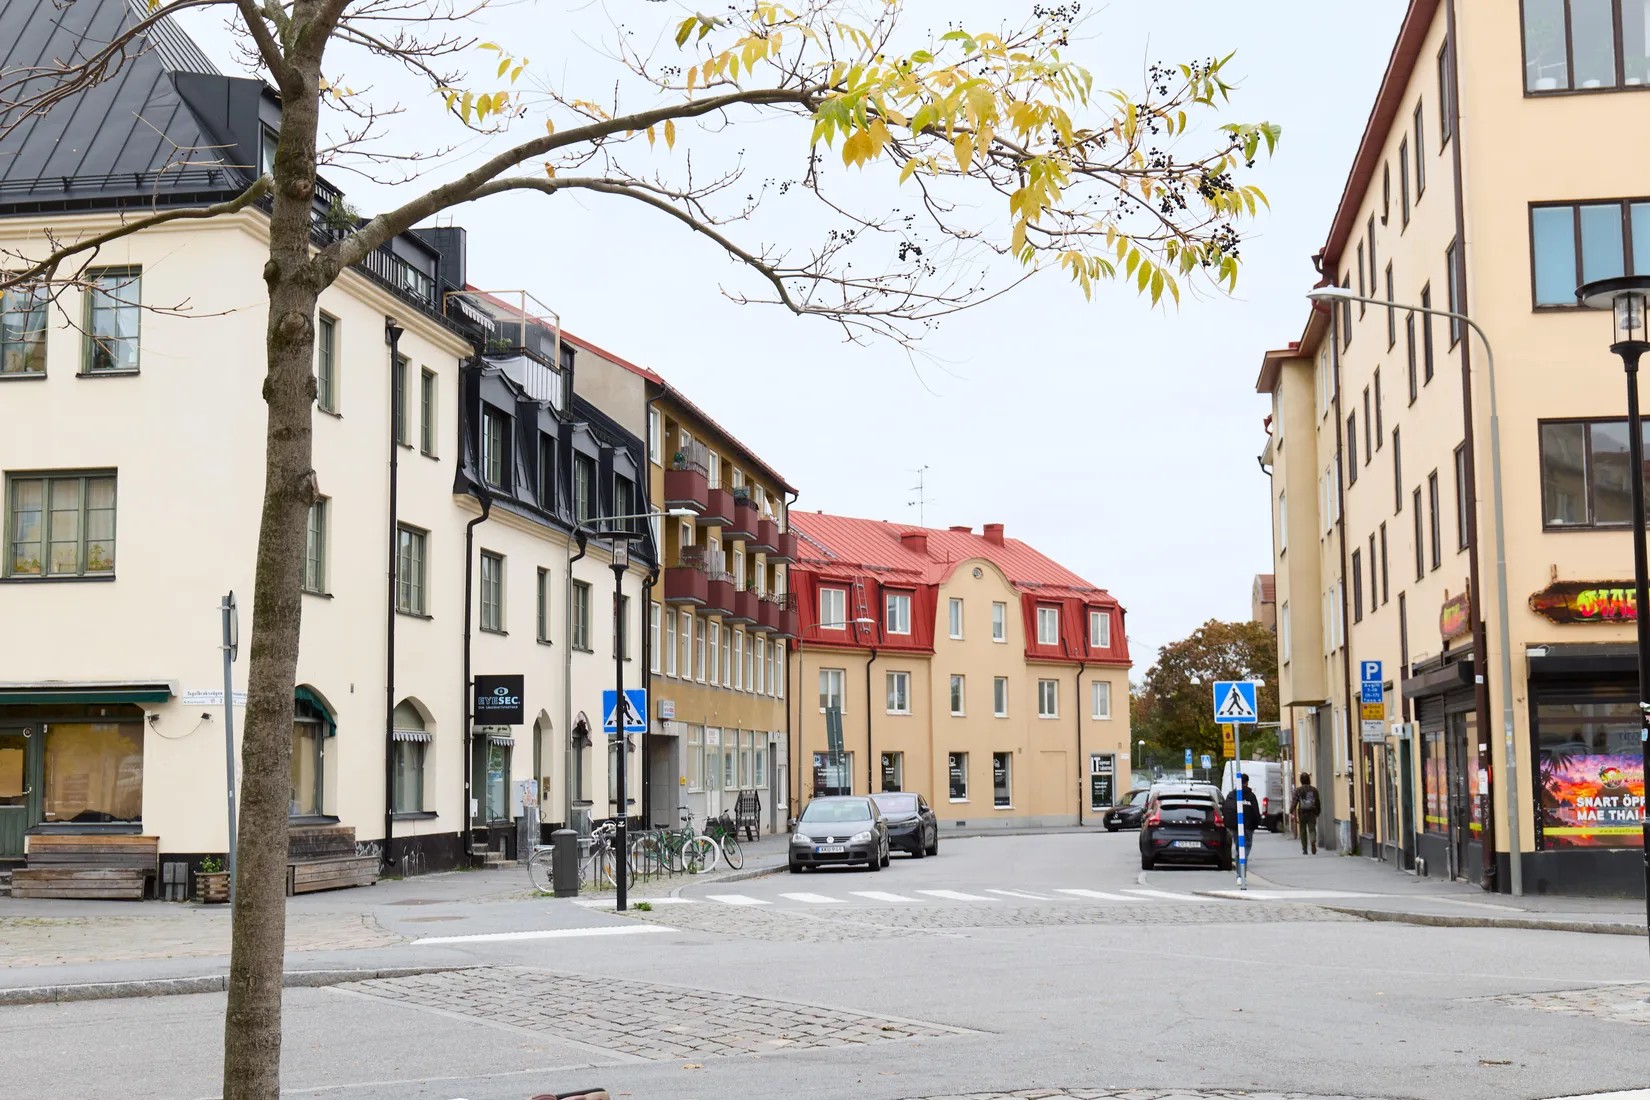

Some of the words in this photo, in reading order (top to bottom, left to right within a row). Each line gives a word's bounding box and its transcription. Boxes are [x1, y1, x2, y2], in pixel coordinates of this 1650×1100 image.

[1366, 662, 1379, 680] P
[478, 696, 518, 705] EYESEC
[1576, 796, 1619, 807] SNART
[1577, 810, 1605, 821] MAE
[1608, 810, 1639, 821] THAI
